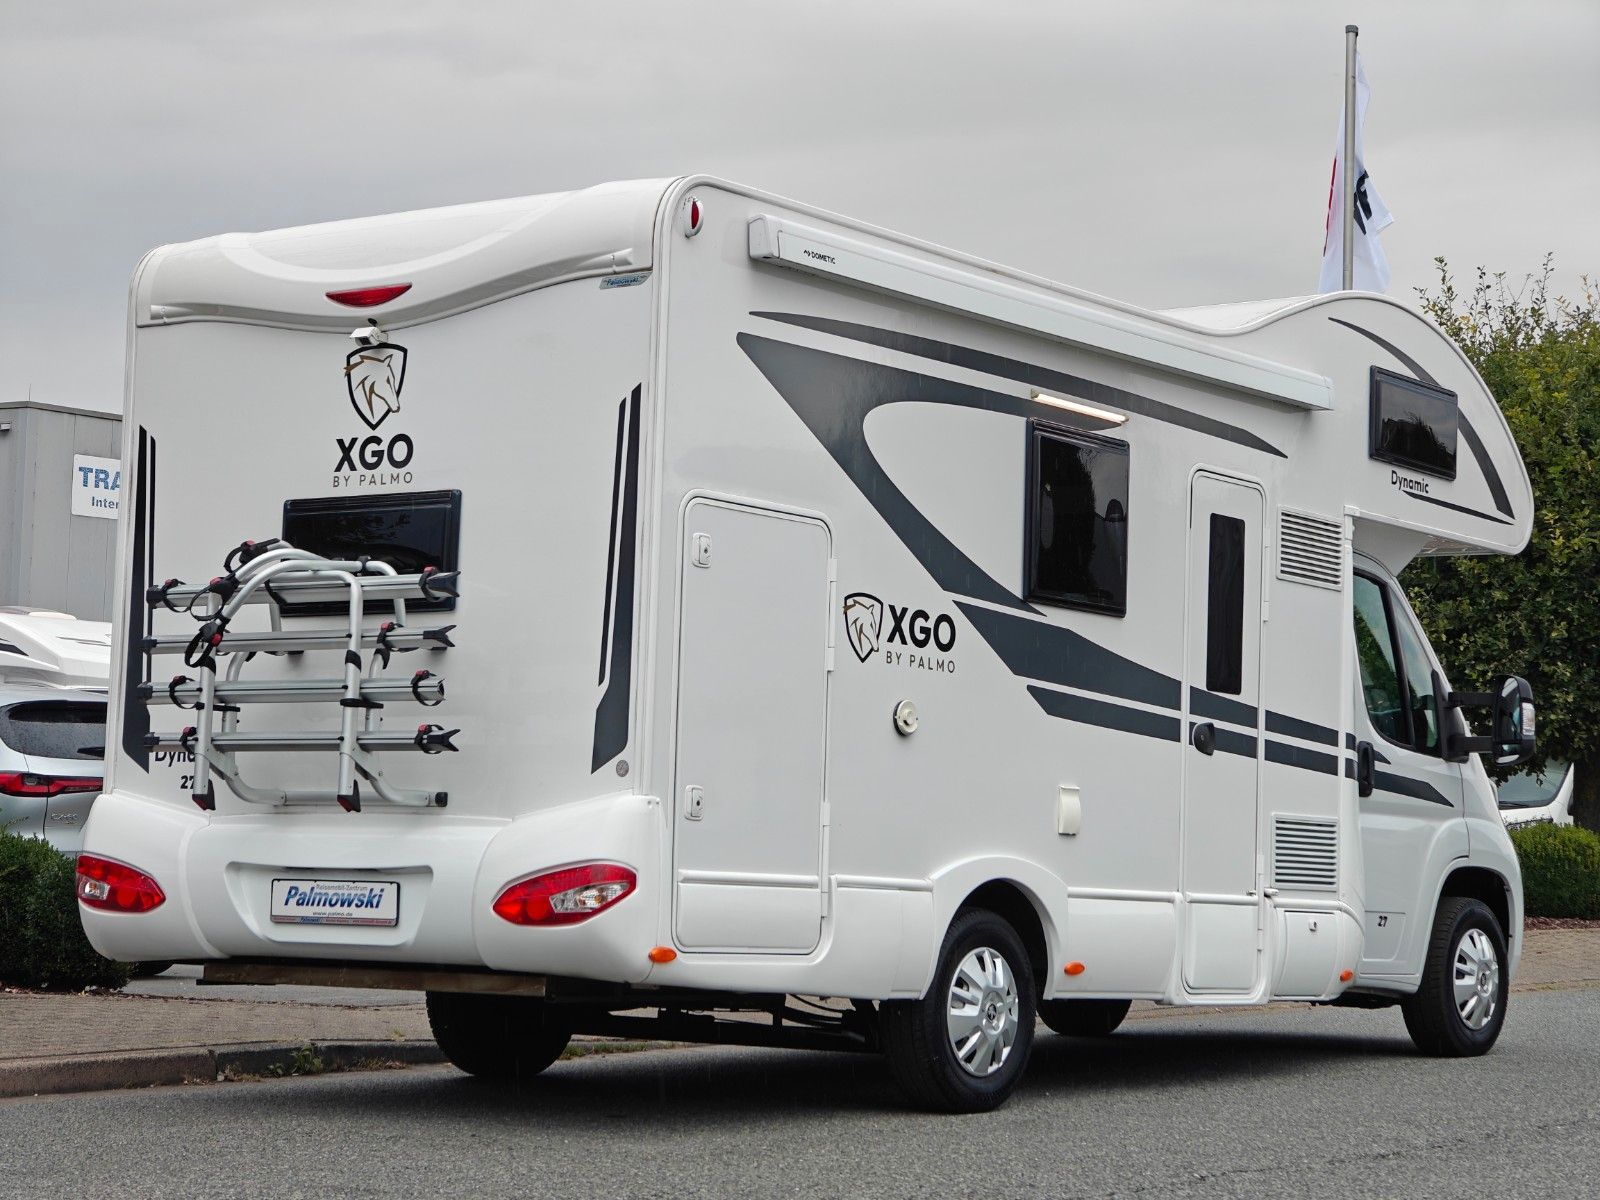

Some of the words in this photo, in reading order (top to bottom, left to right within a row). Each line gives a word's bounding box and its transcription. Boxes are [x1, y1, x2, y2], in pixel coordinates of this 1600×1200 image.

[811, 251, 836, 264] DOMETIC
[334, 433, 414, 473] XGO
[333, 476, 351, 488] BY
[360, 472, 413, 487] PALMO
[1391, 469, 1429, 494] Dynamic
[886, 604, 956, 653] XGO
[886, 651, 902, 665] BY
[909, 655, 956, 674] PALMO
[284, 885, 385, 909] Palmowski
[1377, 915, 1388, 928] 27
